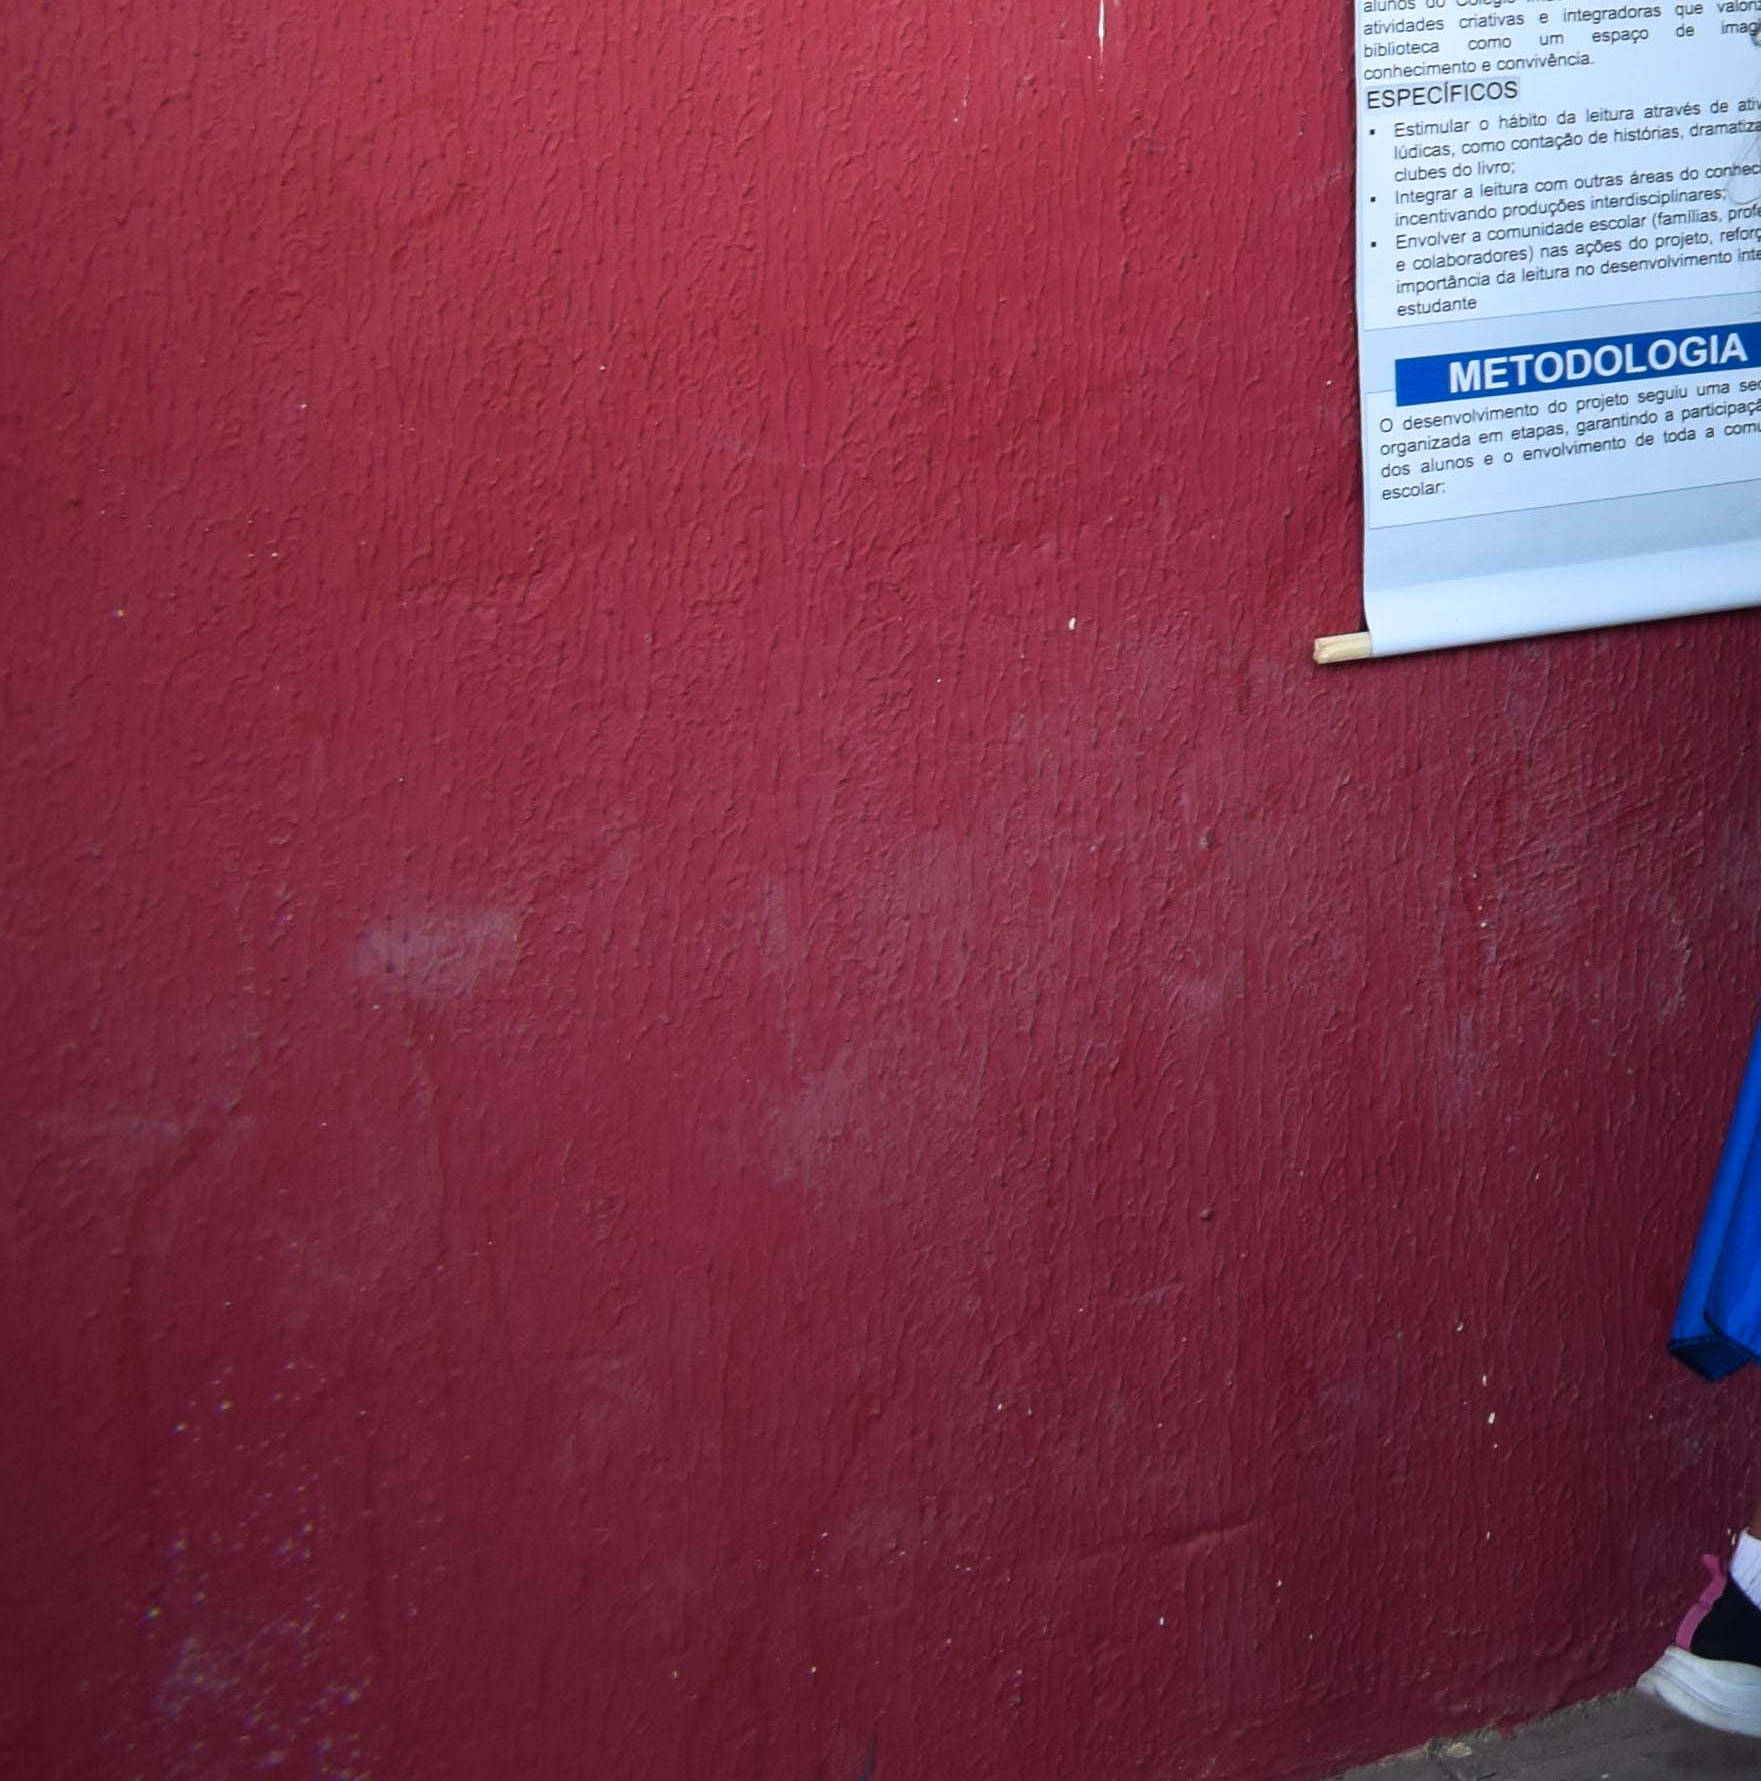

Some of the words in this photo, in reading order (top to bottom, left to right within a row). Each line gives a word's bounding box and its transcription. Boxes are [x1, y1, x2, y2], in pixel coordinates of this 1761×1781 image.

[1363, 17, 1444, 36] atividades
[1459, 12, 1525, 29] criativas
[1538, 12, 1549, 24] e
[1563, 4, 1662, 25] integradoras
[1674, 3, 1703, 19] que
[1363, 60, 1477, 81] conhecimento
[1481, 60, 1491, 72] e
[1367, 80, 1518, 109] ESPECÍFICOS
[1395, 204, 1497, 226] incentivando
[1502, 198, 1586, 220] produções
[1449, 332, 1748, 393] METODOLOGIA
[1379, 432, 1471, 458] organizada
[1478, 430, 1503, 444] em
[1510, 423, 1568, 441] etapas,
[1576, 410, 1658, 436] garantindo
[1664, 410, 1674, 422] a
